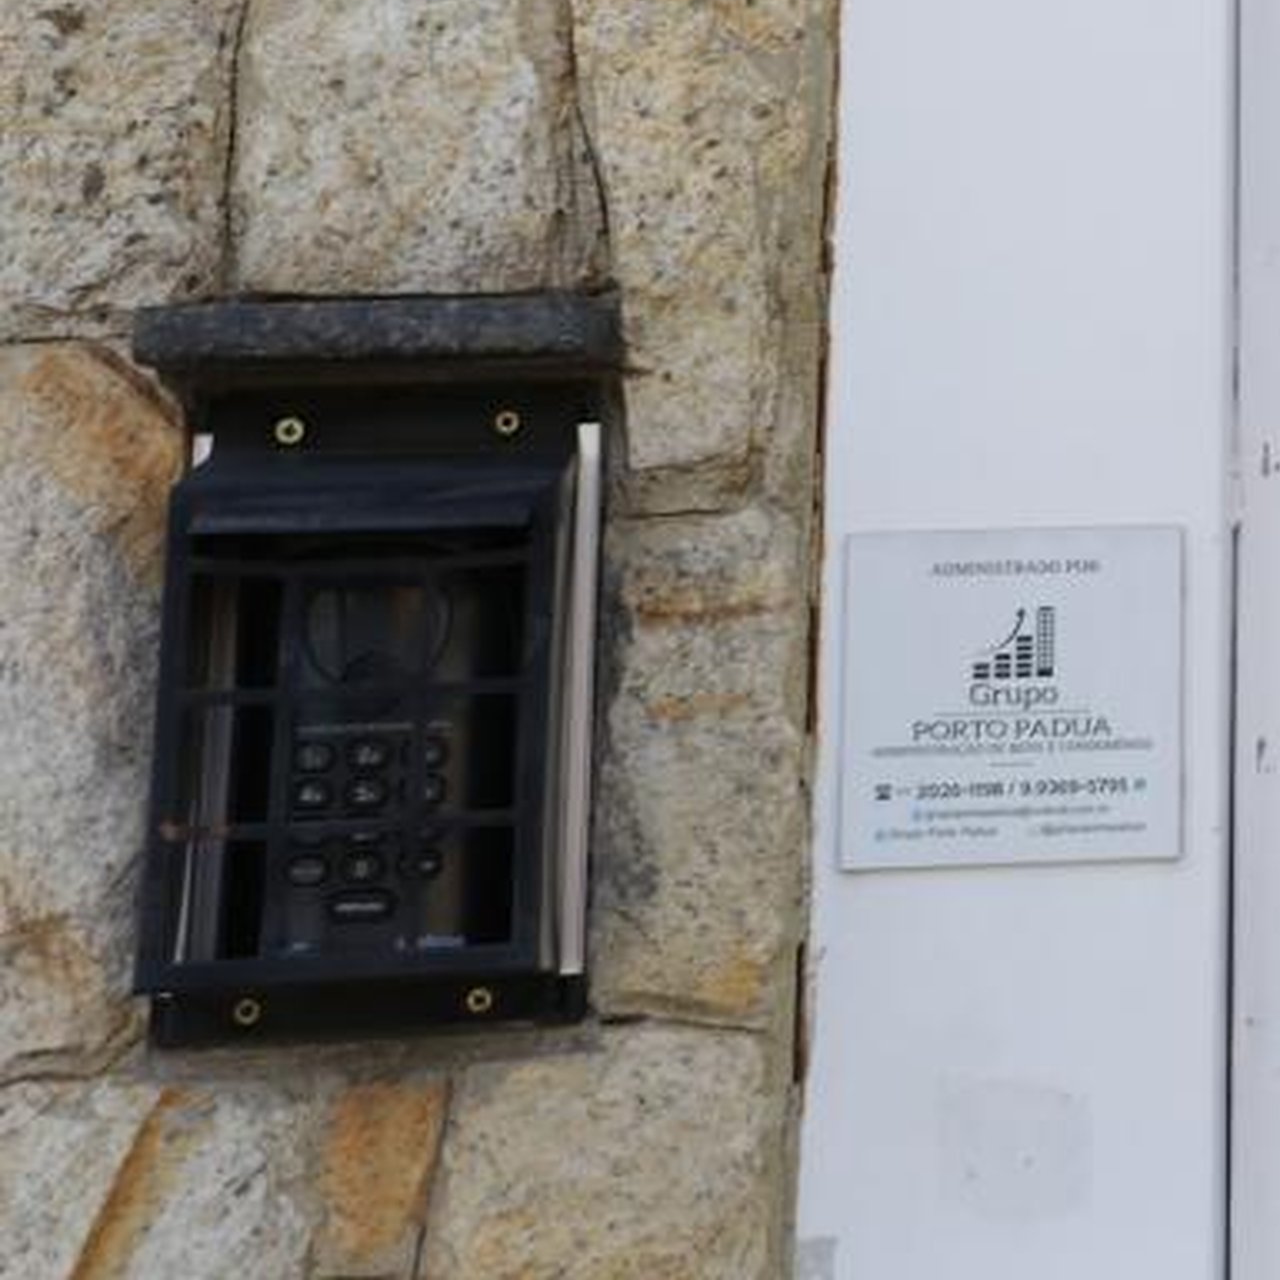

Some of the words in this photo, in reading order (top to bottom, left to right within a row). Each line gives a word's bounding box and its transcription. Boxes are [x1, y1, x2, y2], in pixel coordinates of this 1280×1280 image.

[968, 683, 1059, 711] Grupo
[912, 719, 1009, 742] PORTO
[1014, 717, 1113, 739] PADUA
